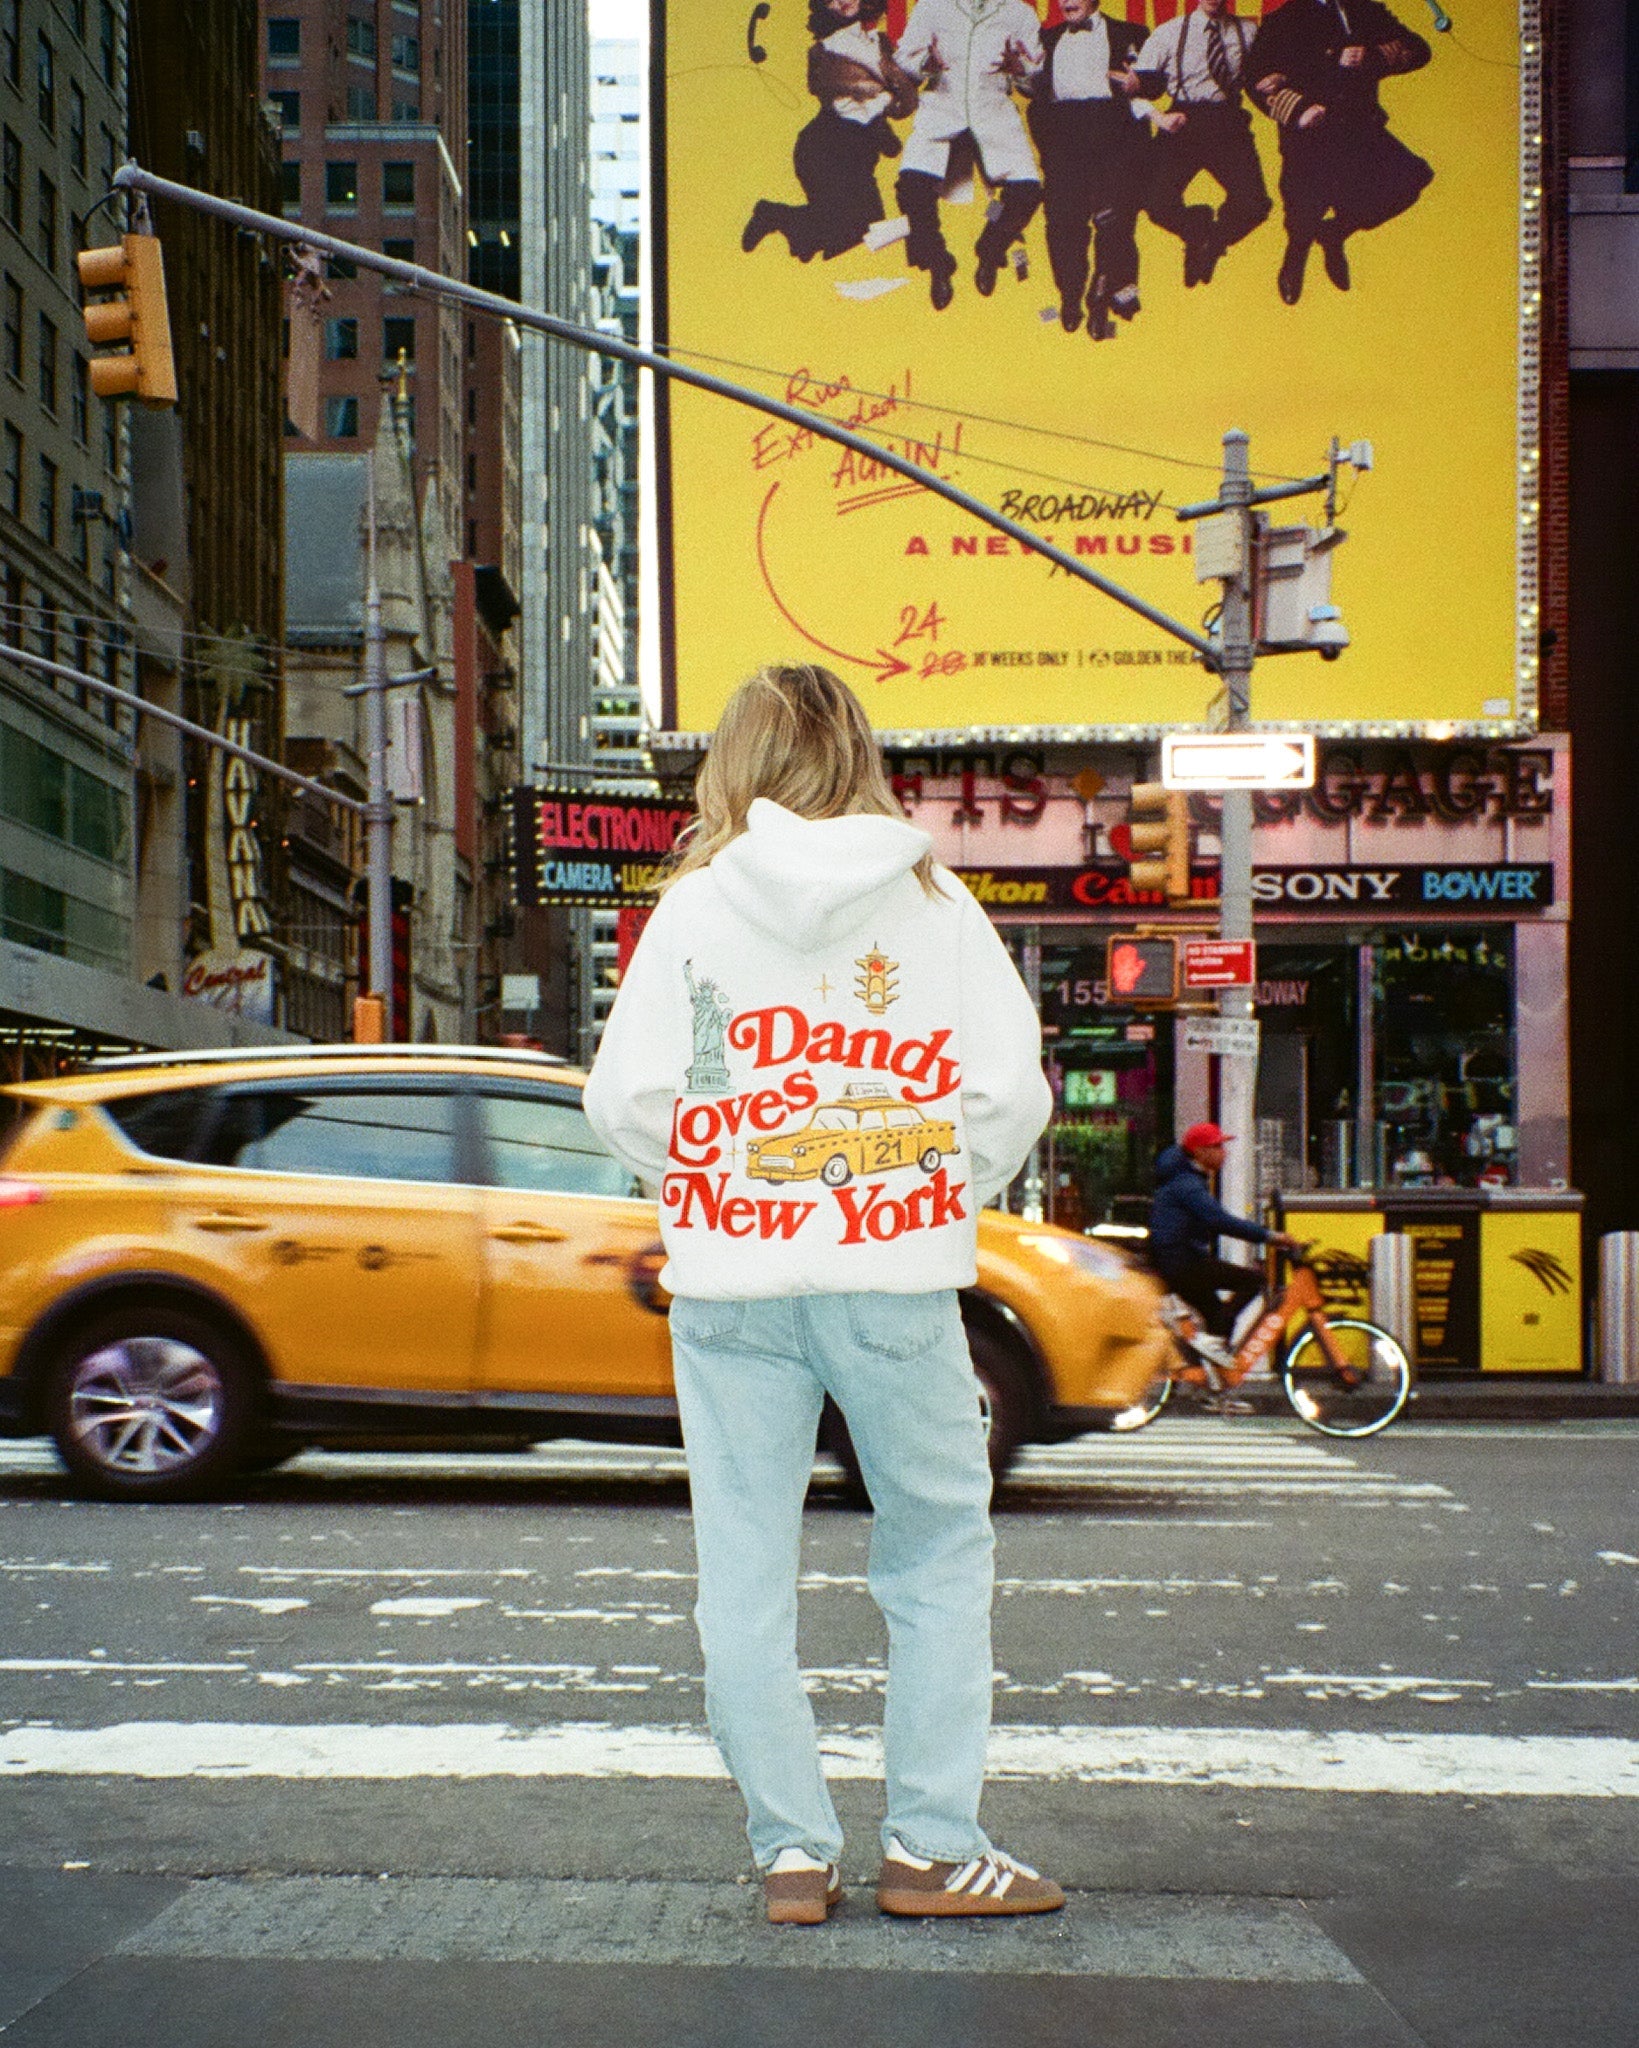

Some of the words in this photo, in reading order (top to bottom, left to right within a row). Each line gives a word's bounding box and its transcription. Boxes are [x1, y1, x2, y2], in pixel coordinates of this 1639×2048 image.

[1001, 489, 1163, 523] BROADWAY
[905, 536, 929, 556] A
[893, 601, 947, 647] 24
[991, 651, 1034, 668] WEEKS
[1037, 651, 1068, 668] ONLY
[1113, 650, 1162, 667] GOLDEN
[225, 718, 265, 937] HAVANA
[544, 861, 615, 891] CAMERA
[958, 872, 1047, 903] ikon
[1072, 872, 1218, 904] Can
[1251, 872, 1399, 900] SONY
[1422, 870, 1537, 900] BOWER
[728, 1005, 962, 1104] Dandy
[667, 1069, 820, 1168] Loves
[875, 1139, 902, 1165] 21
[662, 1172, 818, 1241] New
[832, 1167, 967, 1246] York
